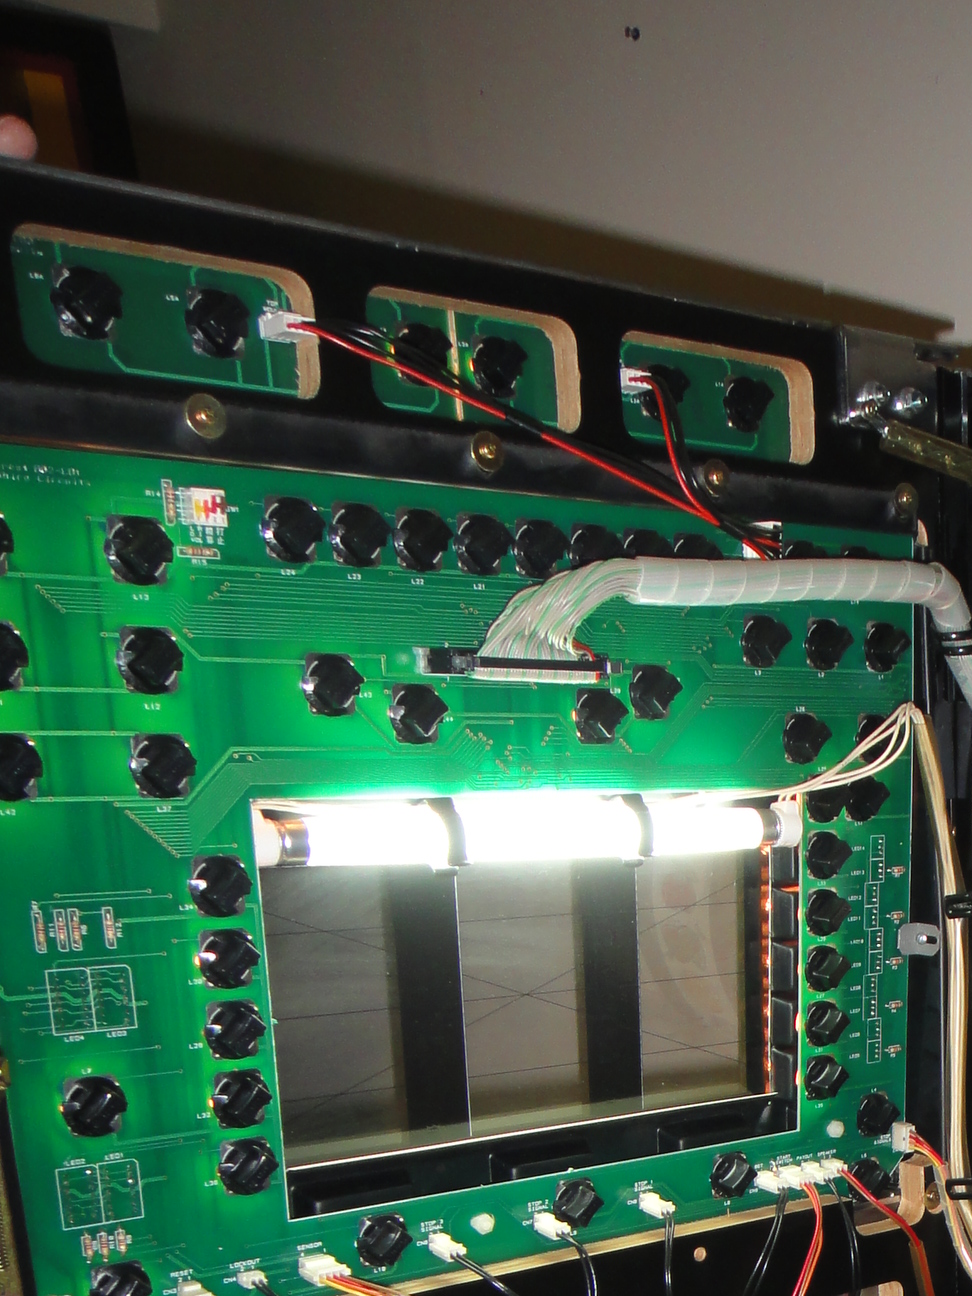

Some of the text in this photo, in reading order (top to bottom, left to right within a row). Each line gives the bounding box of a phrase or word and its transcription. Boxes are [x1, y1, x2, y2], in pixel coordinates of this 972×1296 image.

[297, 1241, 323, 1251] SENSOR
[229, 1258, 261, 1269] LOCKOUT
[170, 1268, 194, 1278] RESET
[223, 1276, 238, 1284] CN4
